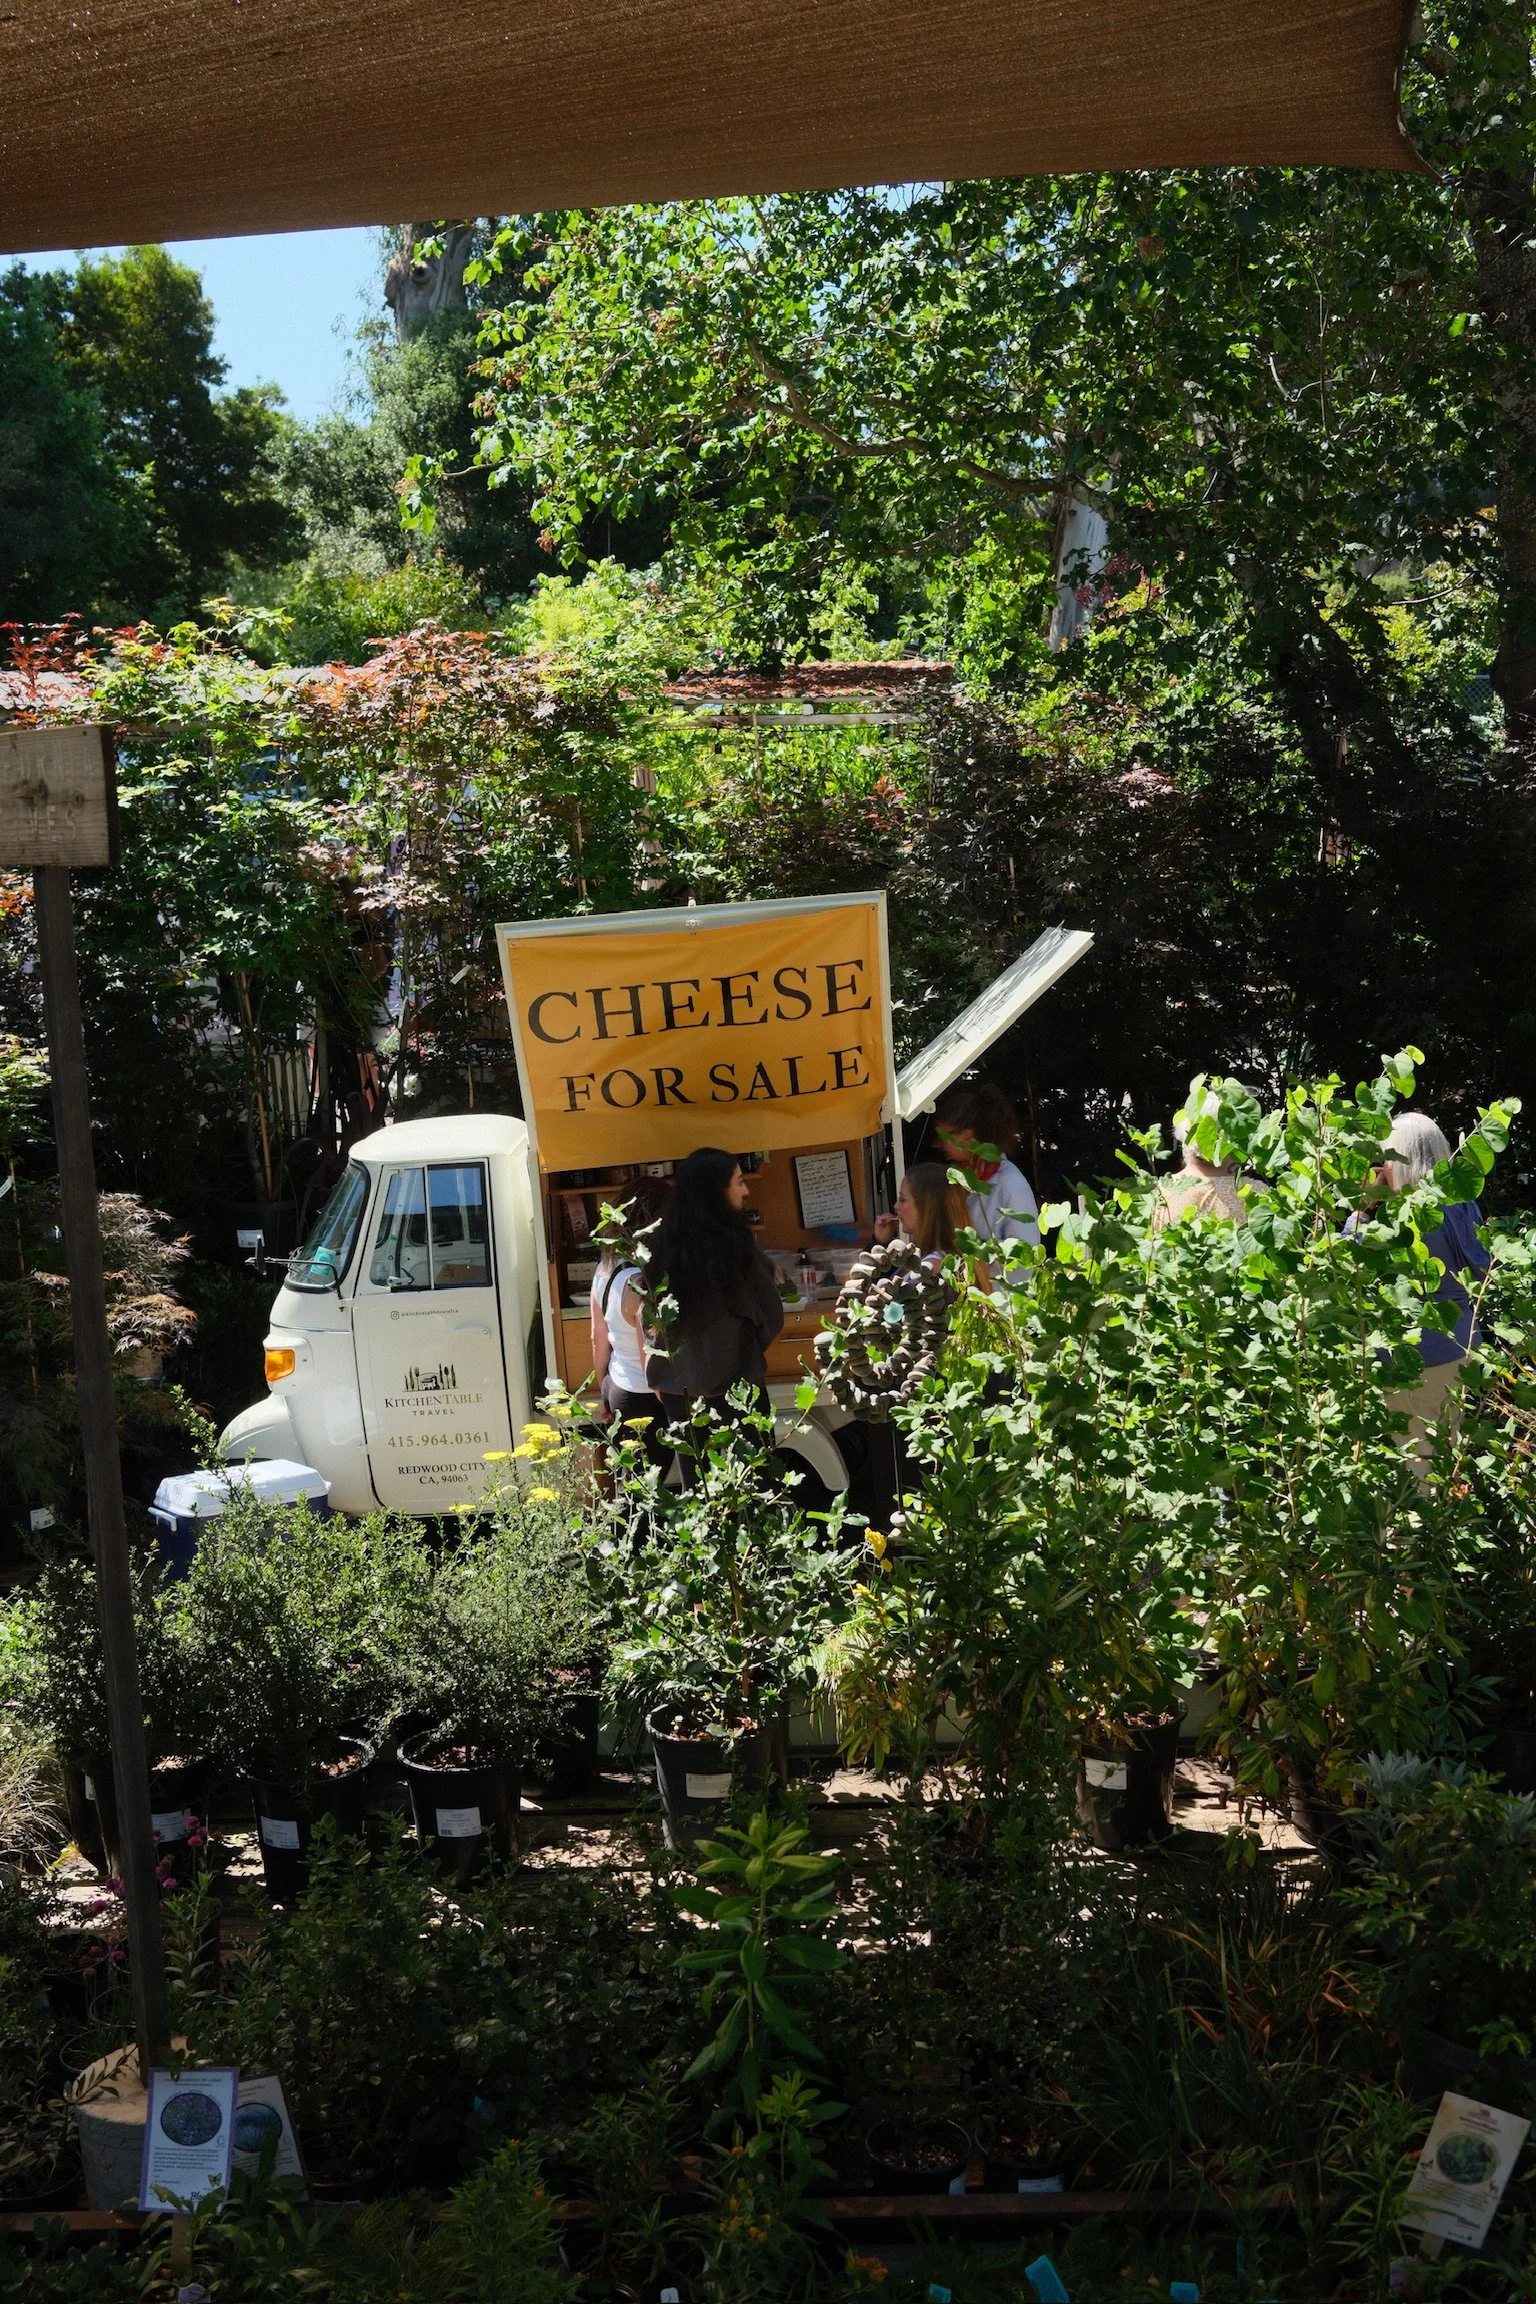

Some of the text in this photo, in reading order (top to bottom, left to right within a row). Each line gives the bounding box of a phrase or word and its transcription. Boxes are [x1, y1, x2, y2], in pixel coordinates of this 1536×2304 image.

[527, 959, 872, 1044] CHEESE
[559, 1045, 870, 1113] FOR SALE
[413, 1408, 456, 1417] TRAVEL
[387, 1431, 490, 1448] 415.964.0361
[398, 1462, 487, 1475] REDWOOD CITY
[419, 1474, 469, 1486] CA, 94063
